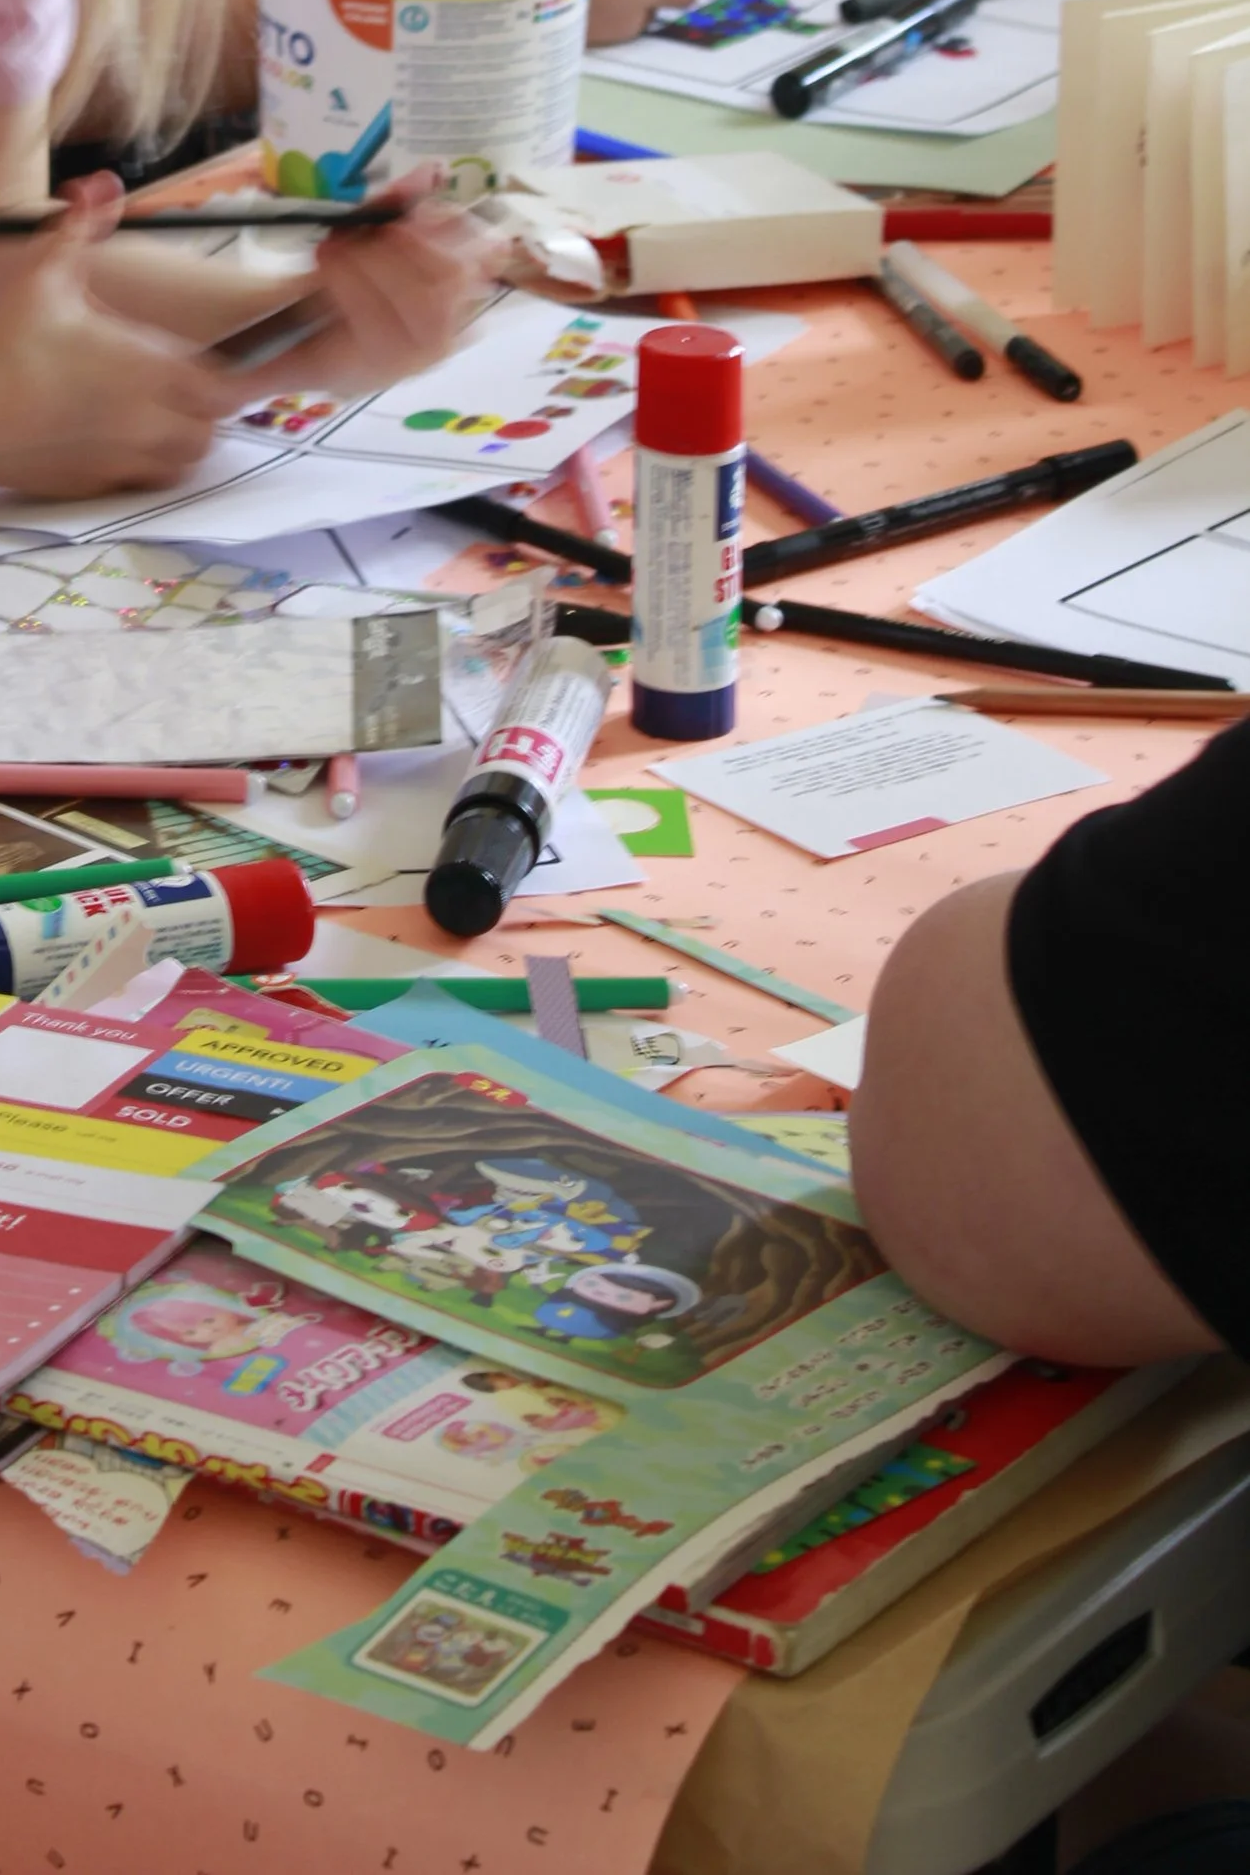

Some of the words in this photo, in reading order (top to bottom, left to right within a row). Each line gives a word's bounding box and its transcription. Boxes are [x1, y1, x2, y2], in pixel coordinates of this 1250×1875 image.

[21, 1011, 88, 1033] Thank
[88, 1026, 139, 1041] you
[199, 1039, 345, 1074] APPROVED
[173, 1059, 295, 1091] URGENT!
[144, 1081, 236, 1107] OFFER
[113, 1105, 193, 1129] SOLD
